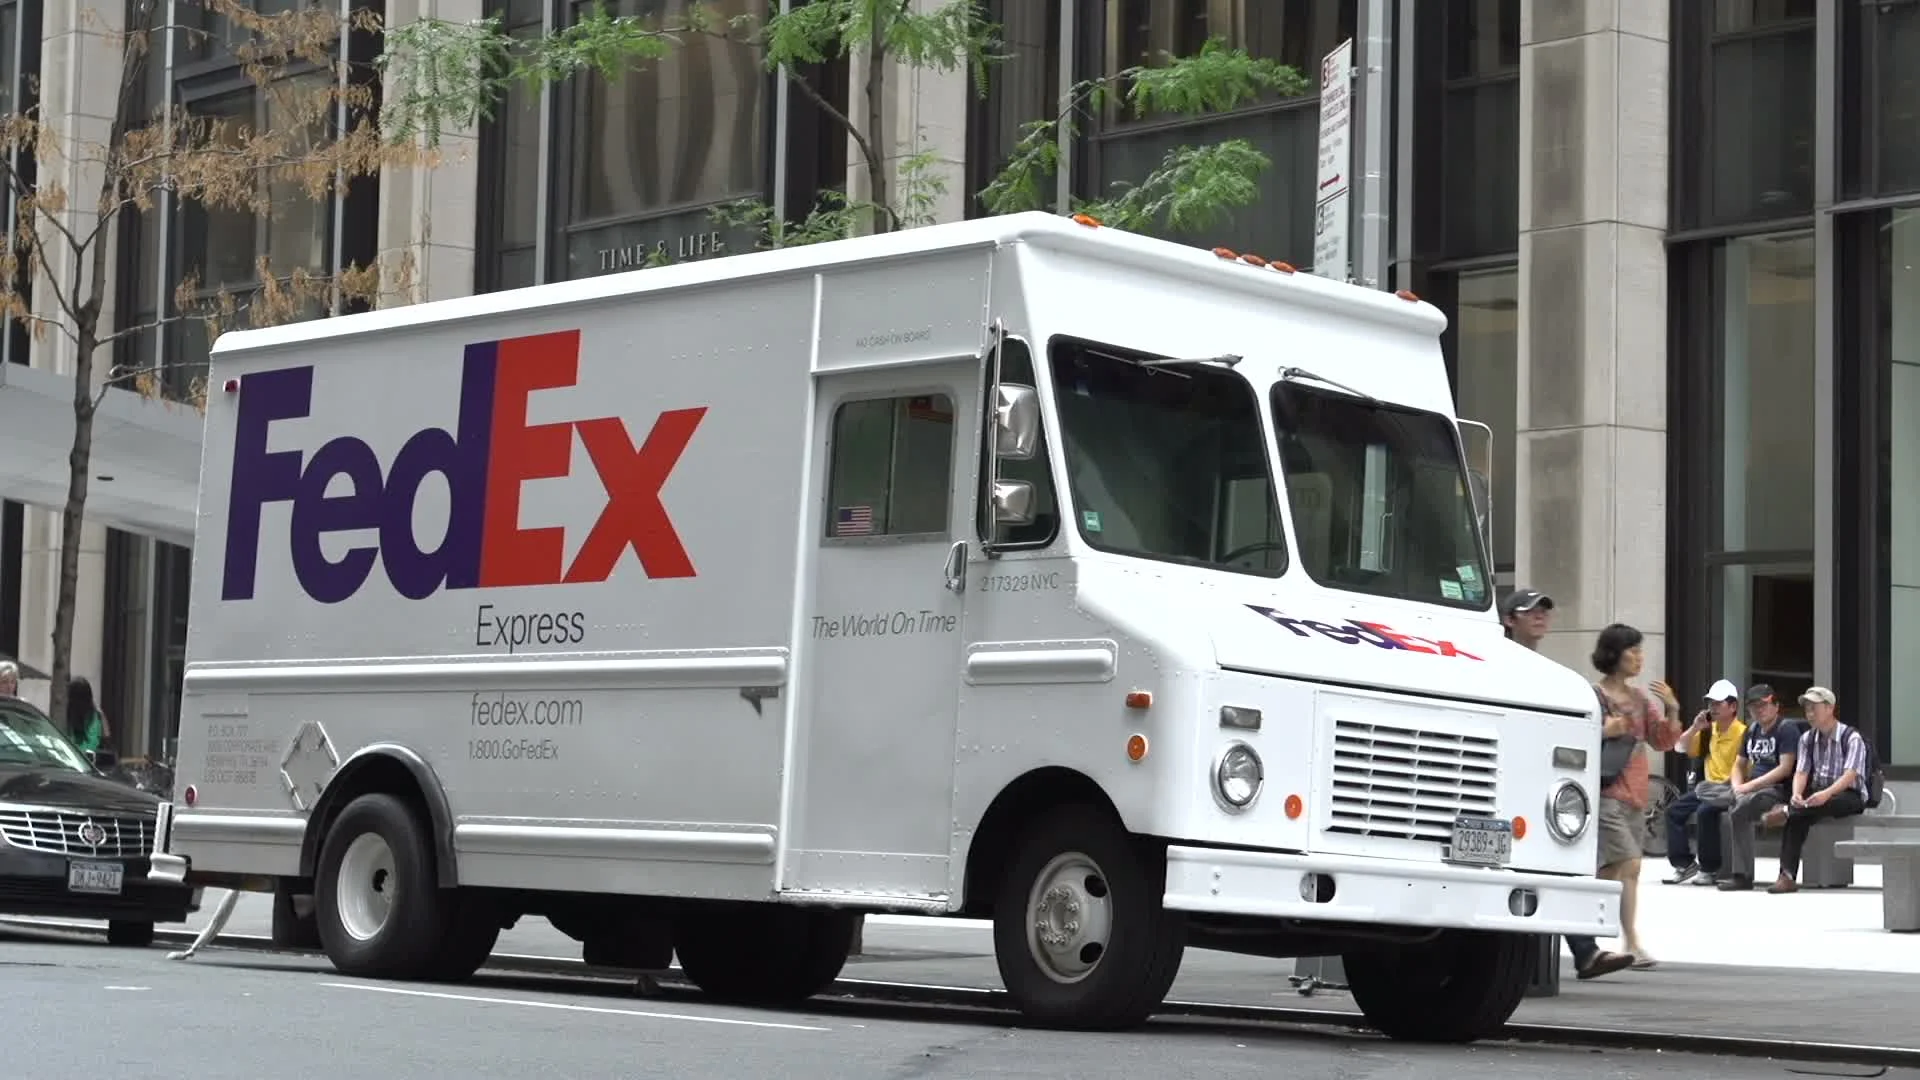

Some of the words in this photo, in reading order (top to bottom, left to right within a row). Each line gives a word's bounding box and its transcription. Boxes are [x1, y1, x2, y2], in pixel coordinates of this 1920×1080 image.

[599, 243, 645, 270] TIME
[679, 231, 720, 258] LIFE
[221, 328, 709, 603] FedEx
[980, 575, 1029, 592] 217329
[1031, 572, 1059, 590] NYC
[477, 604, 585, 654] Express
[811, 616, 840, 639] The
[842, 613, 888, 637] World
[891, 611, 915, 634] On
[918, 610, 957, 633] Time
[1242, 604, 1486, 662] FedEx
[471, 692, 583, 726] fedex.com
[469, 738, 559, 760] 1.800.GoFedEx
